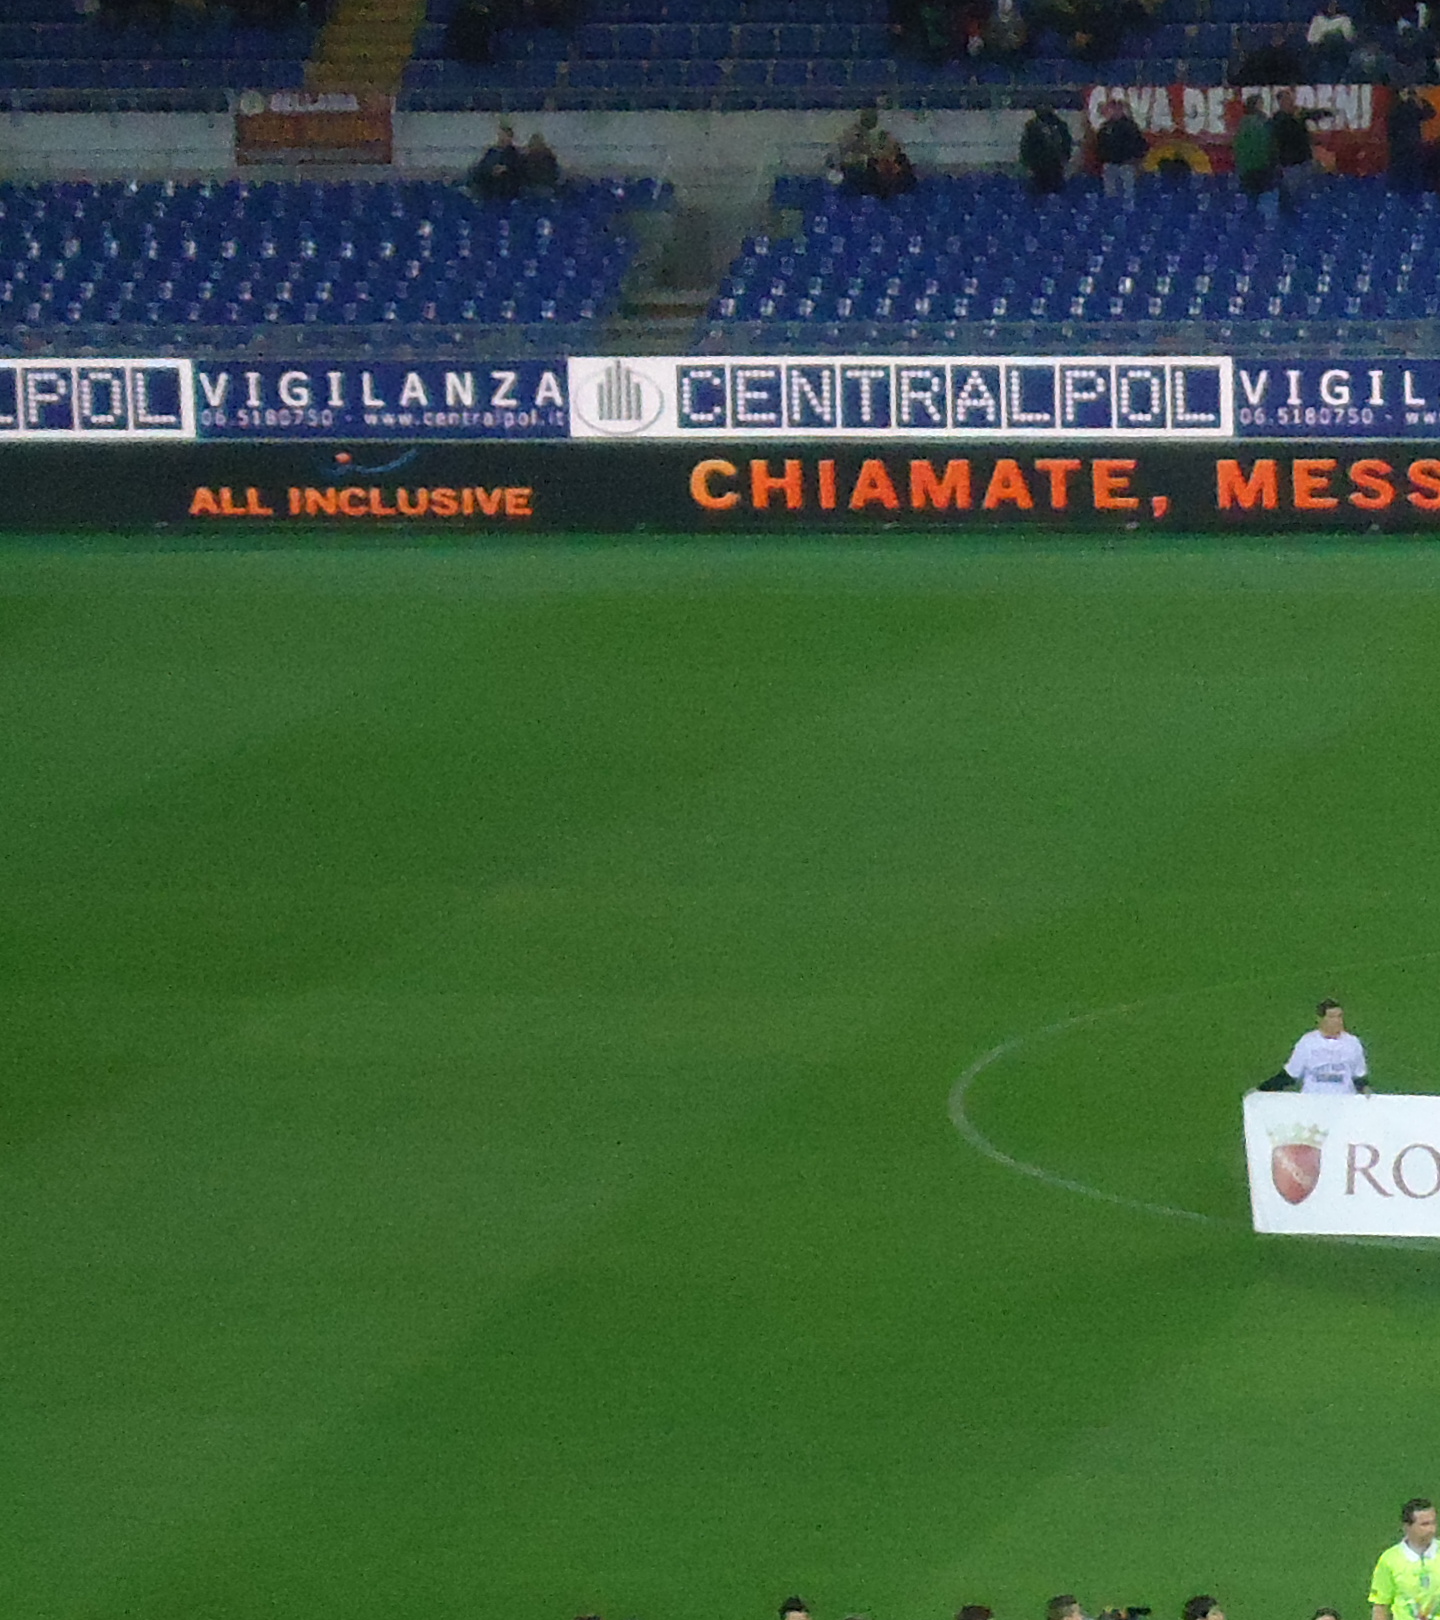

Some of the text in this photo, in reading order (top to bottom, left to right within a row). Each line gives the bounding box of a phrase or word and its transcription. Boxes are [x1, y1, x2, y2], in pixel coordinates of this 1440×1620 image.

[199, 369, 564, 408] VIGILANZA
[682, 367, 1217, 424] CENTRALPOL
[189, 485, 535, 517] ALL INCLUSIVE
[688, 457, 1171, 518] CHIAMATE,
